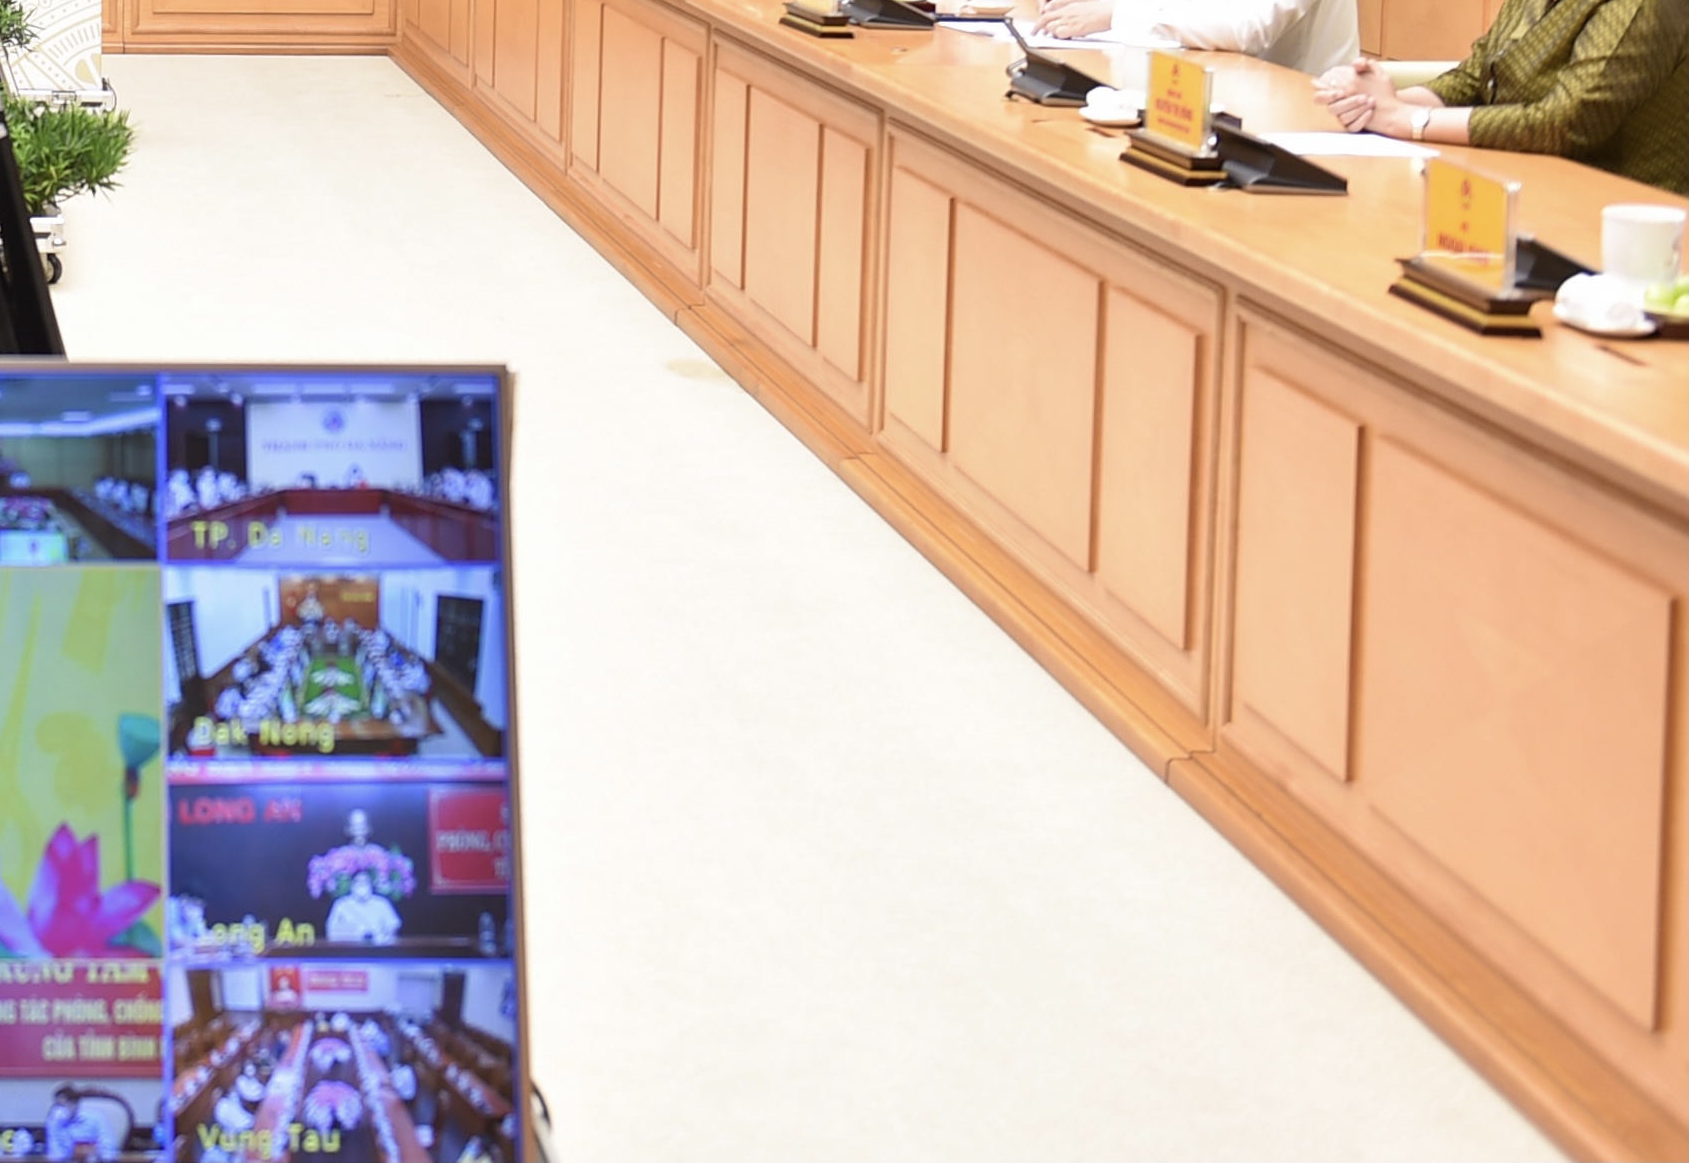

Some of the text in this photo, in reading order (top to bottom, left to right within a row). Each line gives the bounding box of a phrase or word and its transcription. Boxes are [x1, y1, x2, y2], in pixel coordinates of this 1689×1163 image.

[248, 521, 282, 547] Da
[259, 717, 335, 753] Nong
[274, 917, 315, 947] An
[197, 1123, 341, 1160] Vung Tau
